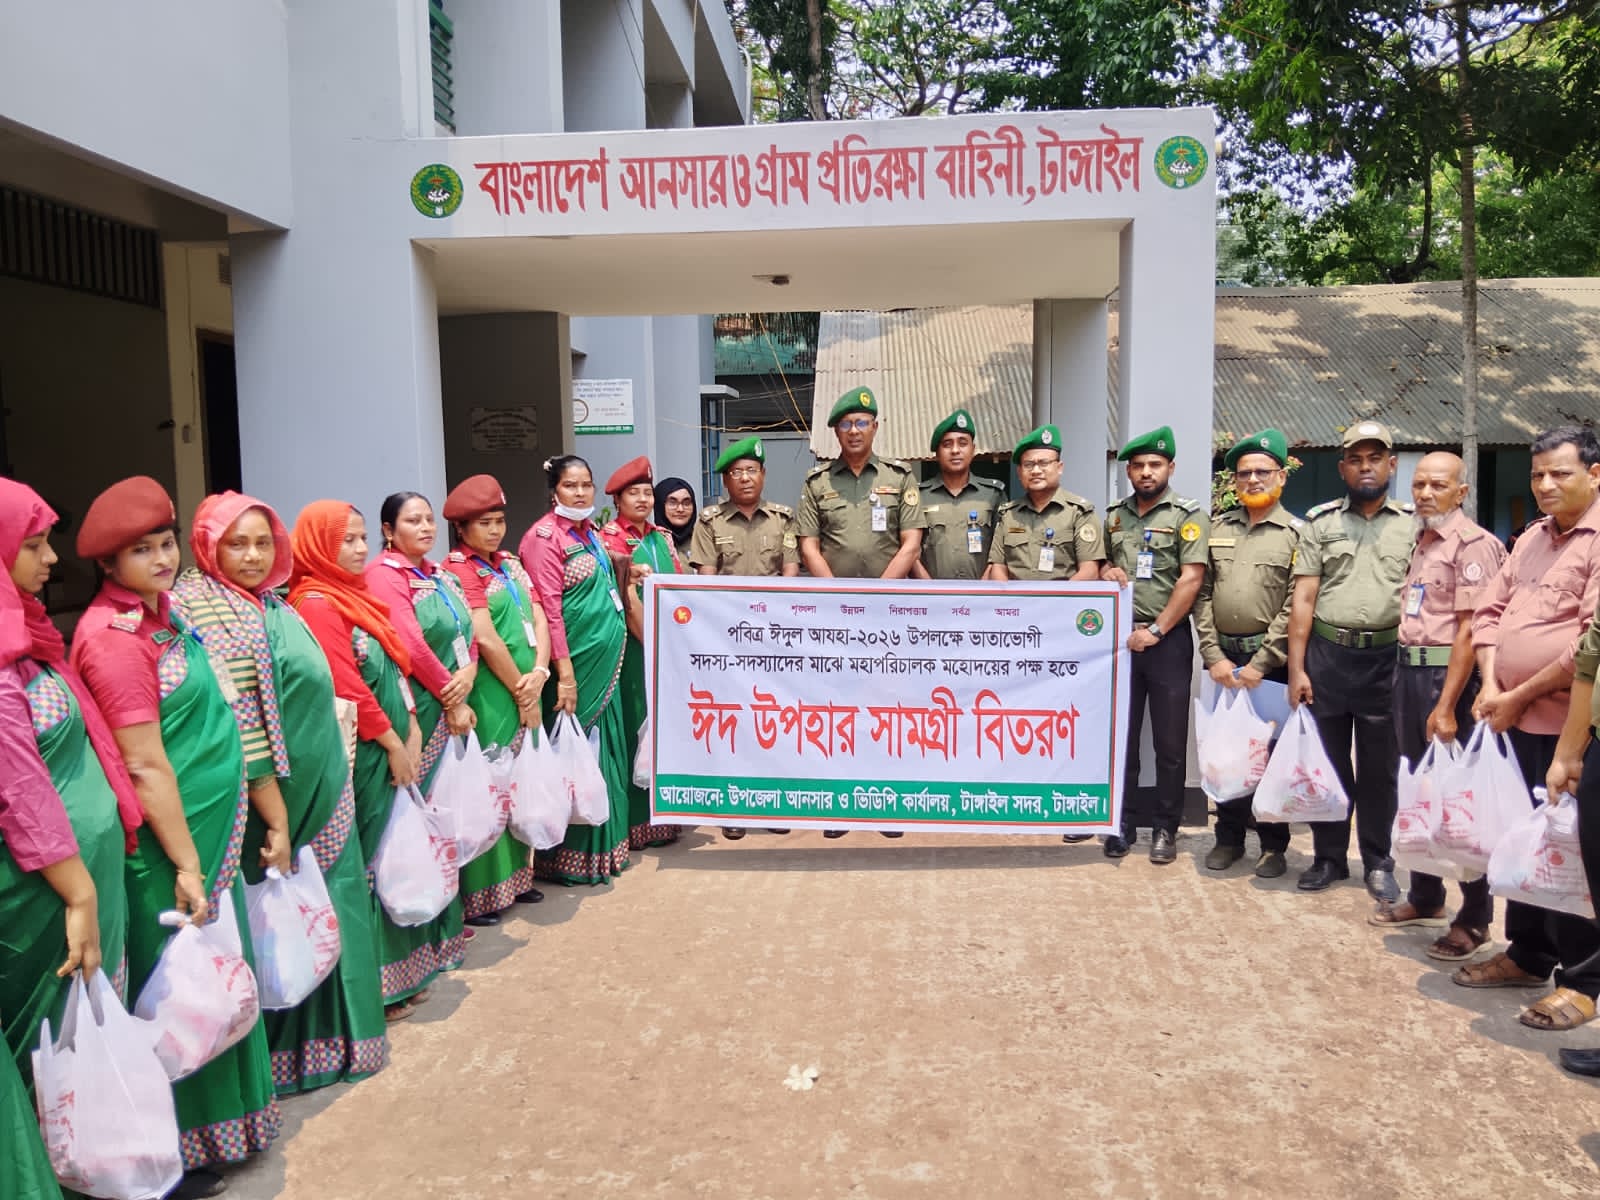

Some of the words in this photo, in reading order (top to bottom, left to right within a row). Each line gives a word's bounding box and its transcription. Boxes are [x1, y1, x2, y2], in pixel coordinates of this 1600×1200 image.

[473, 146, 610, 216] বাংলাদেশ
[619, 154, 729, 210] আনসার
[731, 153, 752, 209] ও
[755, 142, 811, 206] গ্রাম
[816, 133, 928, 204] প্রতিরক্ষা
[993, 607, 1021, 617] আমরা
[727, 620, 766, 644] পবিত্র
[767, 621, 805, 649] ঈদুল
[807, 627, 901, 649] আযহা-২০২৬
[905, 624, 965, 648] উপলক্ষে
[967, 624, 1044, 649] ভাতাভোগী
[689, 653, 806, 673] সদস্য-সদস্যাদের
[807, 655, 845, 673] মাঝে
[847, 651, 937, 676] মহাপরিচালক
[940, 658, 1012, 677] মহোদয়ের
[1015, 658, 1045, 677] পক্ষ
[1046, 660, 1081, 678] হতে
[687, 682, 744, 754] ঈদ
[749, 684, 861, 760] উপহার
[866, 684, 965, 761] সামগ্রী
[970, 687, 1081, 762] বিতরণ
[727, 783, 783, 809] উপজেলা
[784, 789, 835, 810] আনসার
[837, 792, 849, 809] ও
[851, 786, 899, 812] ভিডিপি
